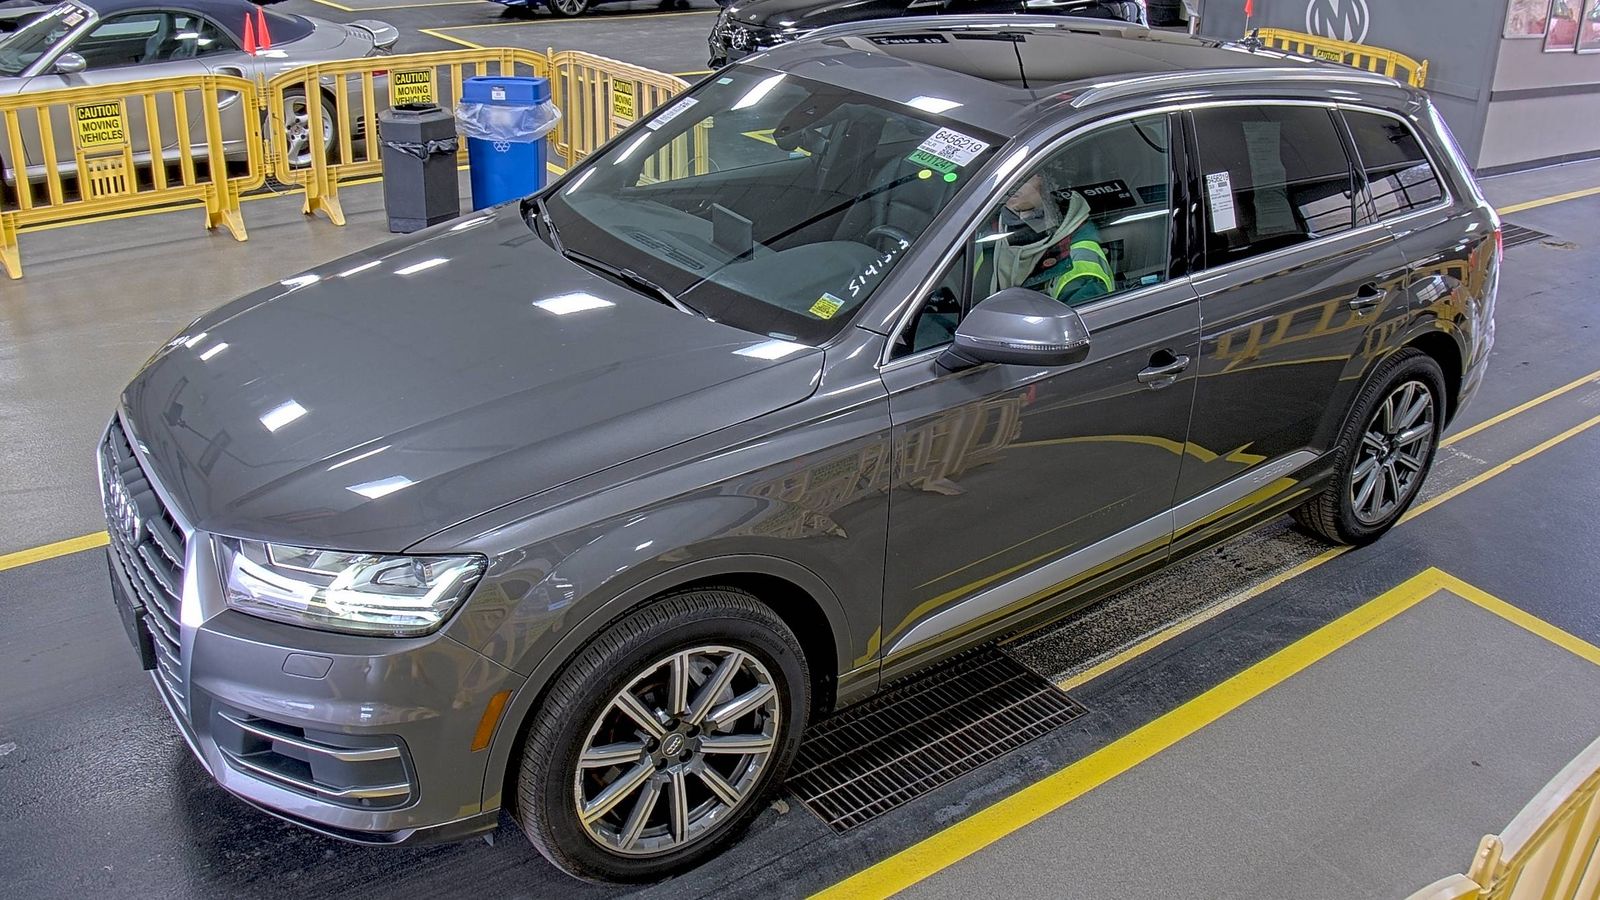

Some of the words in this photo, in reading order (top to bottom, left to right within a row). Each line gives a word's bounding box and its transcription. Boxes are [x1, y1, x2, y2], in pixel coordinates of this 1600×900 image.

[395, 71, 429, 84] CAUTION
[397, 85, 428, 96] MOVING
[395, 95, 431, 104] VEHICLES
[78, 104, 119, 119] CAUTION
[82, 119, 119, 132] MOVING
[80, 130, 123, 143] VEHICLES
[935, 130, 983, 153] 6456219
